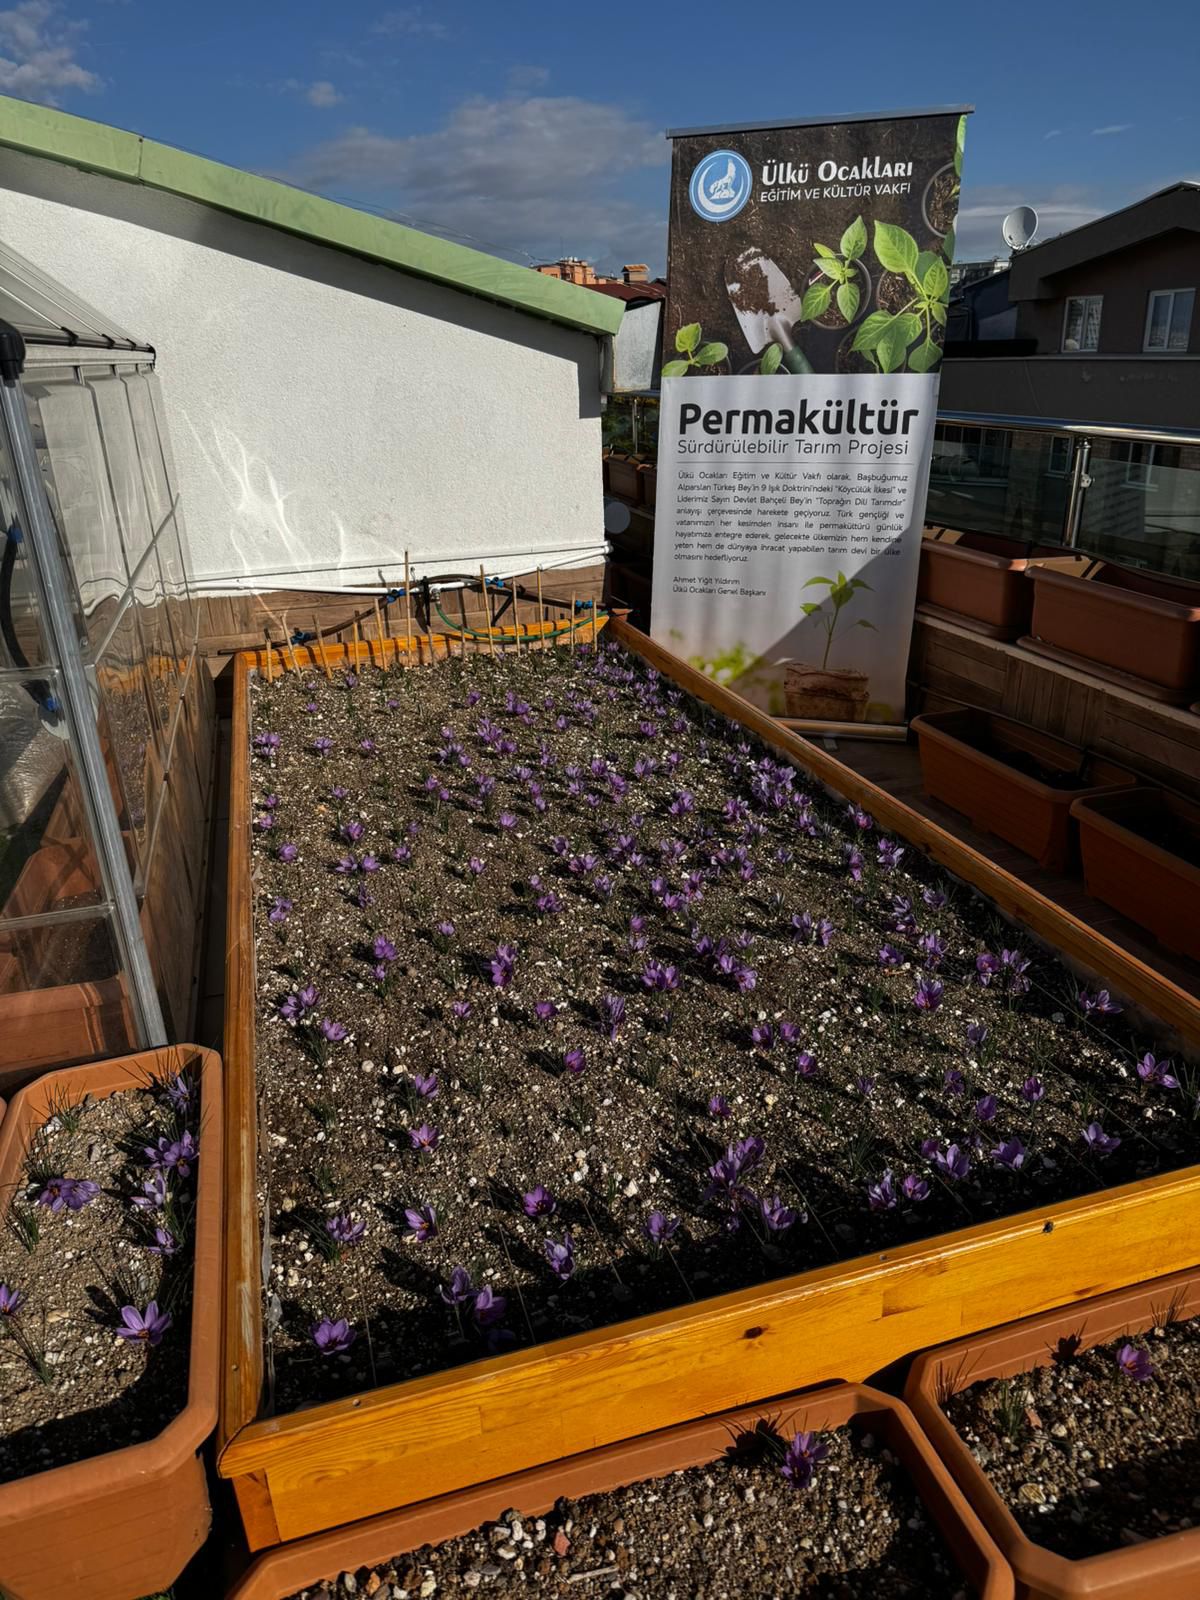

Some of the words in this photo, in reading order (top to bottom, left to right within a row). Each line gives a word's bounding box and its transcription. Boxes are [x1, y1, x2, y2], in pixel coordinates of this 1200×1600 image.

[760, 187, 800, 202] EĞİTİM
[804, 188, 820, 199] VE
[823, 183, 871, 198] KÜLTÜR
[874, 183, 911, 194] VAKFI
[679, 398, 919, 435] Permakültür
[678, 439, 788, 454] Sürdürülebilir
[795, 439, 840, 454] Tarım
[848, 440, 908, 459] Projesi
[678, 470, 694, 479] Ülkü
[733, 472, 756, 481] Eğitim
[857, 473, 908, 483] Başbuğumuz
[714, 484, 736, 492] Türkeş
[760, 496, 786, 505] Bahçeli
[876, 523, 903, 532] günlük
[727, 544, 757, 552] dünyaya
